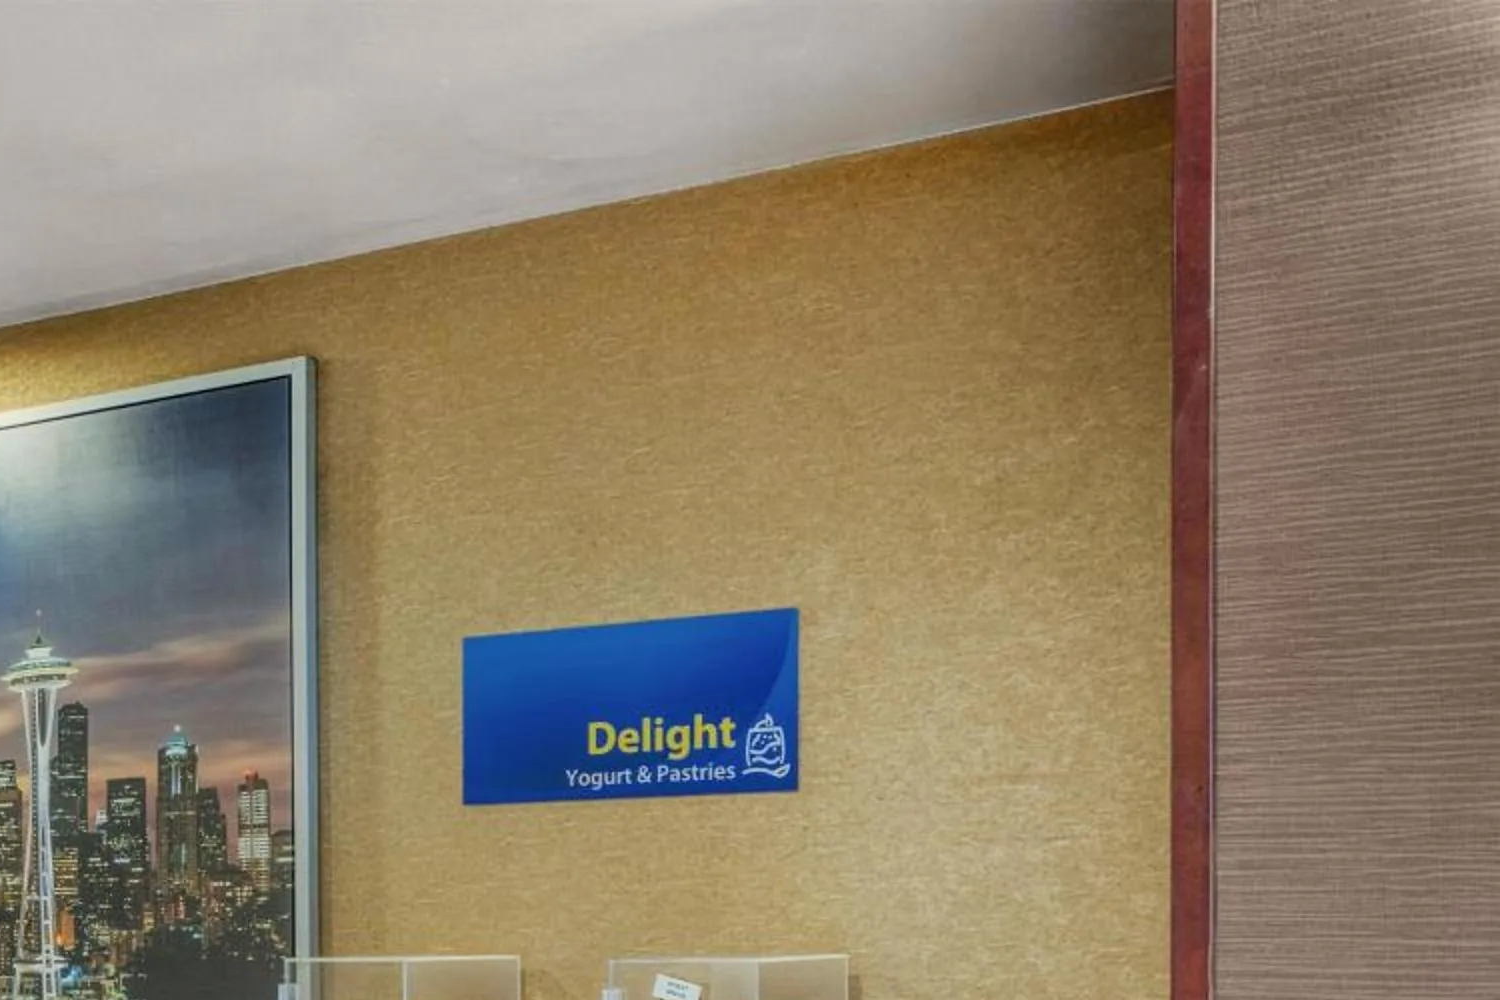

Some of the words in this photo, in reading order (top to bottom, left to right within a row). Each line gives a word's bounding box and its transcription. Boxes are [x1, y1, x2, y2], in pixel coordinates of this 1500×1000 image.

[587, 713, 736, 760] Delight
[565, 769, 633, 790] Yogurt
[637, 765, 652, 783] &
[657, 762, 736, 783] Pastries
